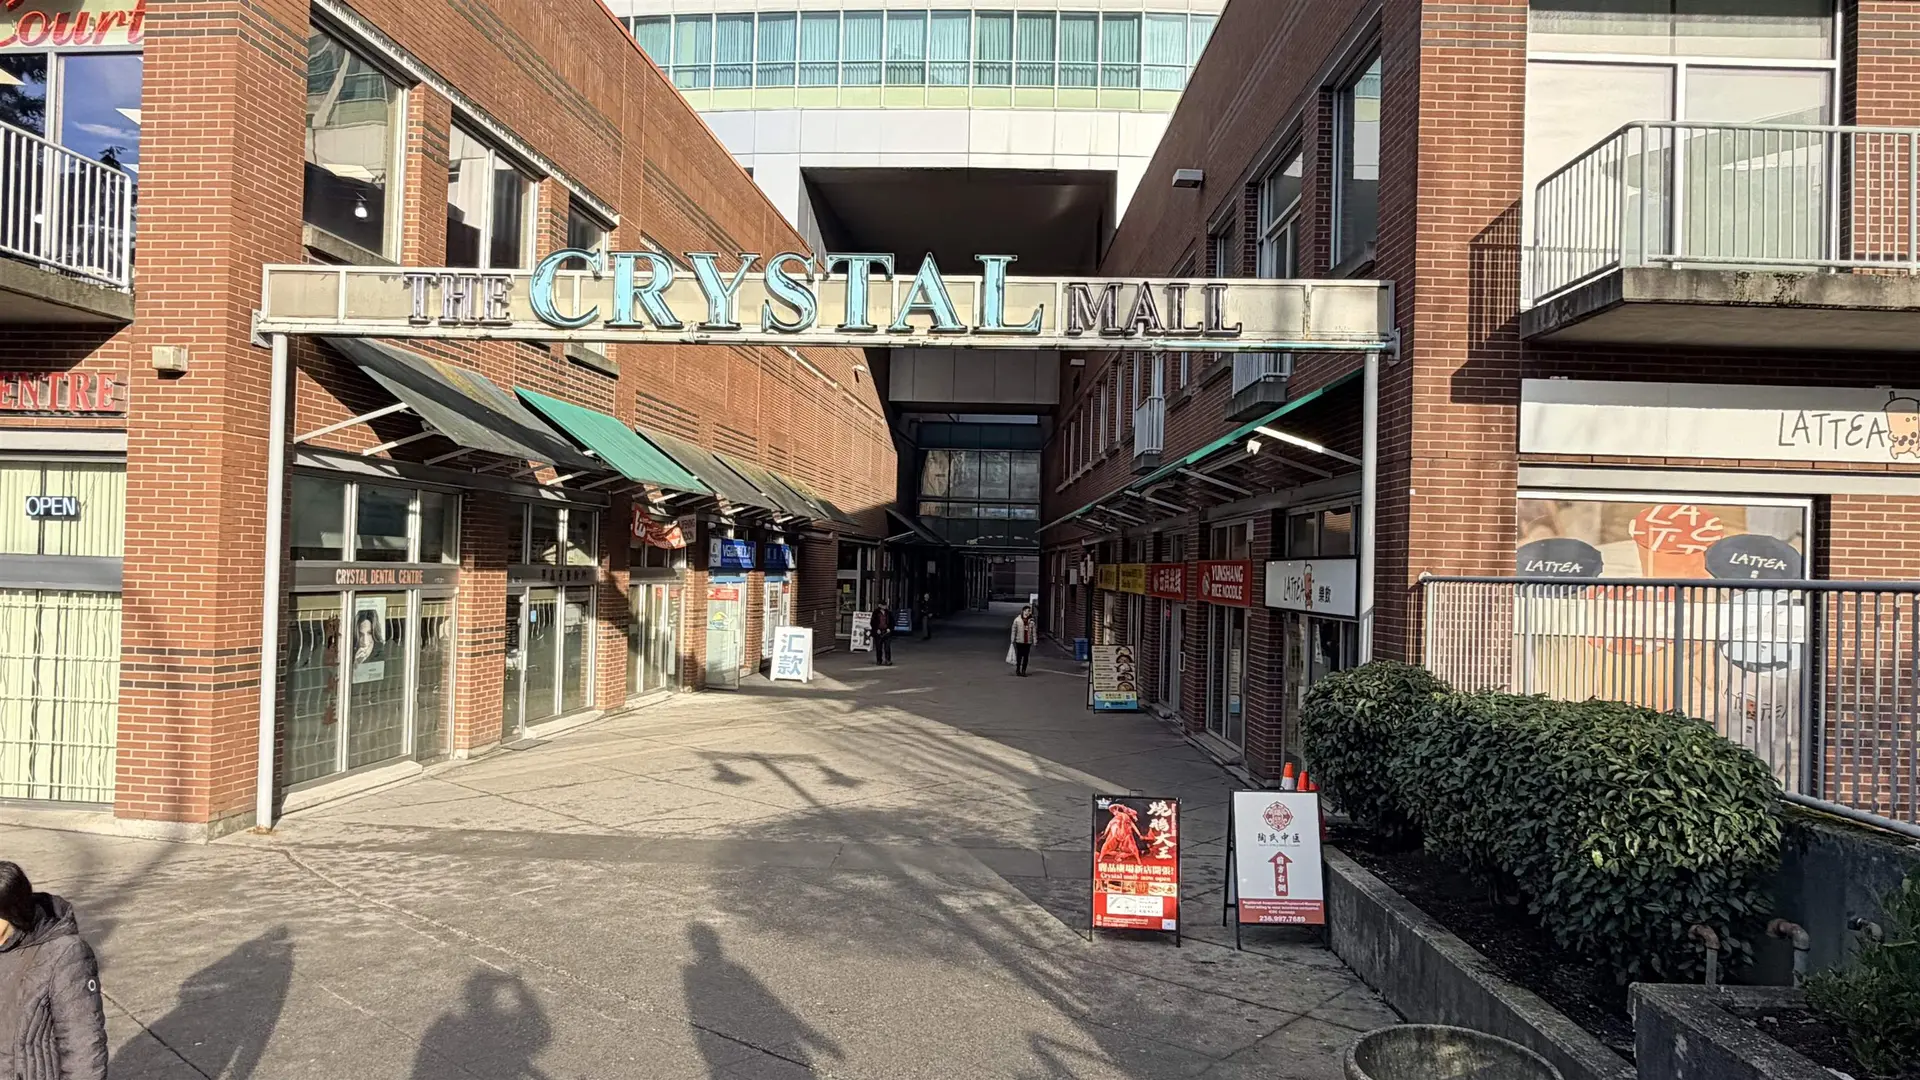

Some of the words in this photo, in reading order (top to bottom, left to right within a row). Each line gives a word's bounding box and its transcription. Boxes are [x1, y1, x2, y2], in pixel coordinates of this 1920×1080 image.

[404, 272, 514, 325] THE
[529, 248, 1044, 335] CRYSTAL
[1067, 281, 1242, 337] MALL
[1779, 410, 1888, 450] LATTEA
[26, 496, 76, 516] OPEN
[1525, 559, 1583, 574] LATTEA
[1729, 552, 1788, 571] LATTEA
[336, 568, 369, 585] CRYSTAL
[370, 569, 397, 585] DENTAL
[398, 569, 424, 584] CENTRE
[1211, 565, 1244, 583] YUNSHANG
[1211, 583, 1222, 598] RICE
[1222, 584, 1243, 600] NOODLE
[777, 633, 805, 676] 汇款
